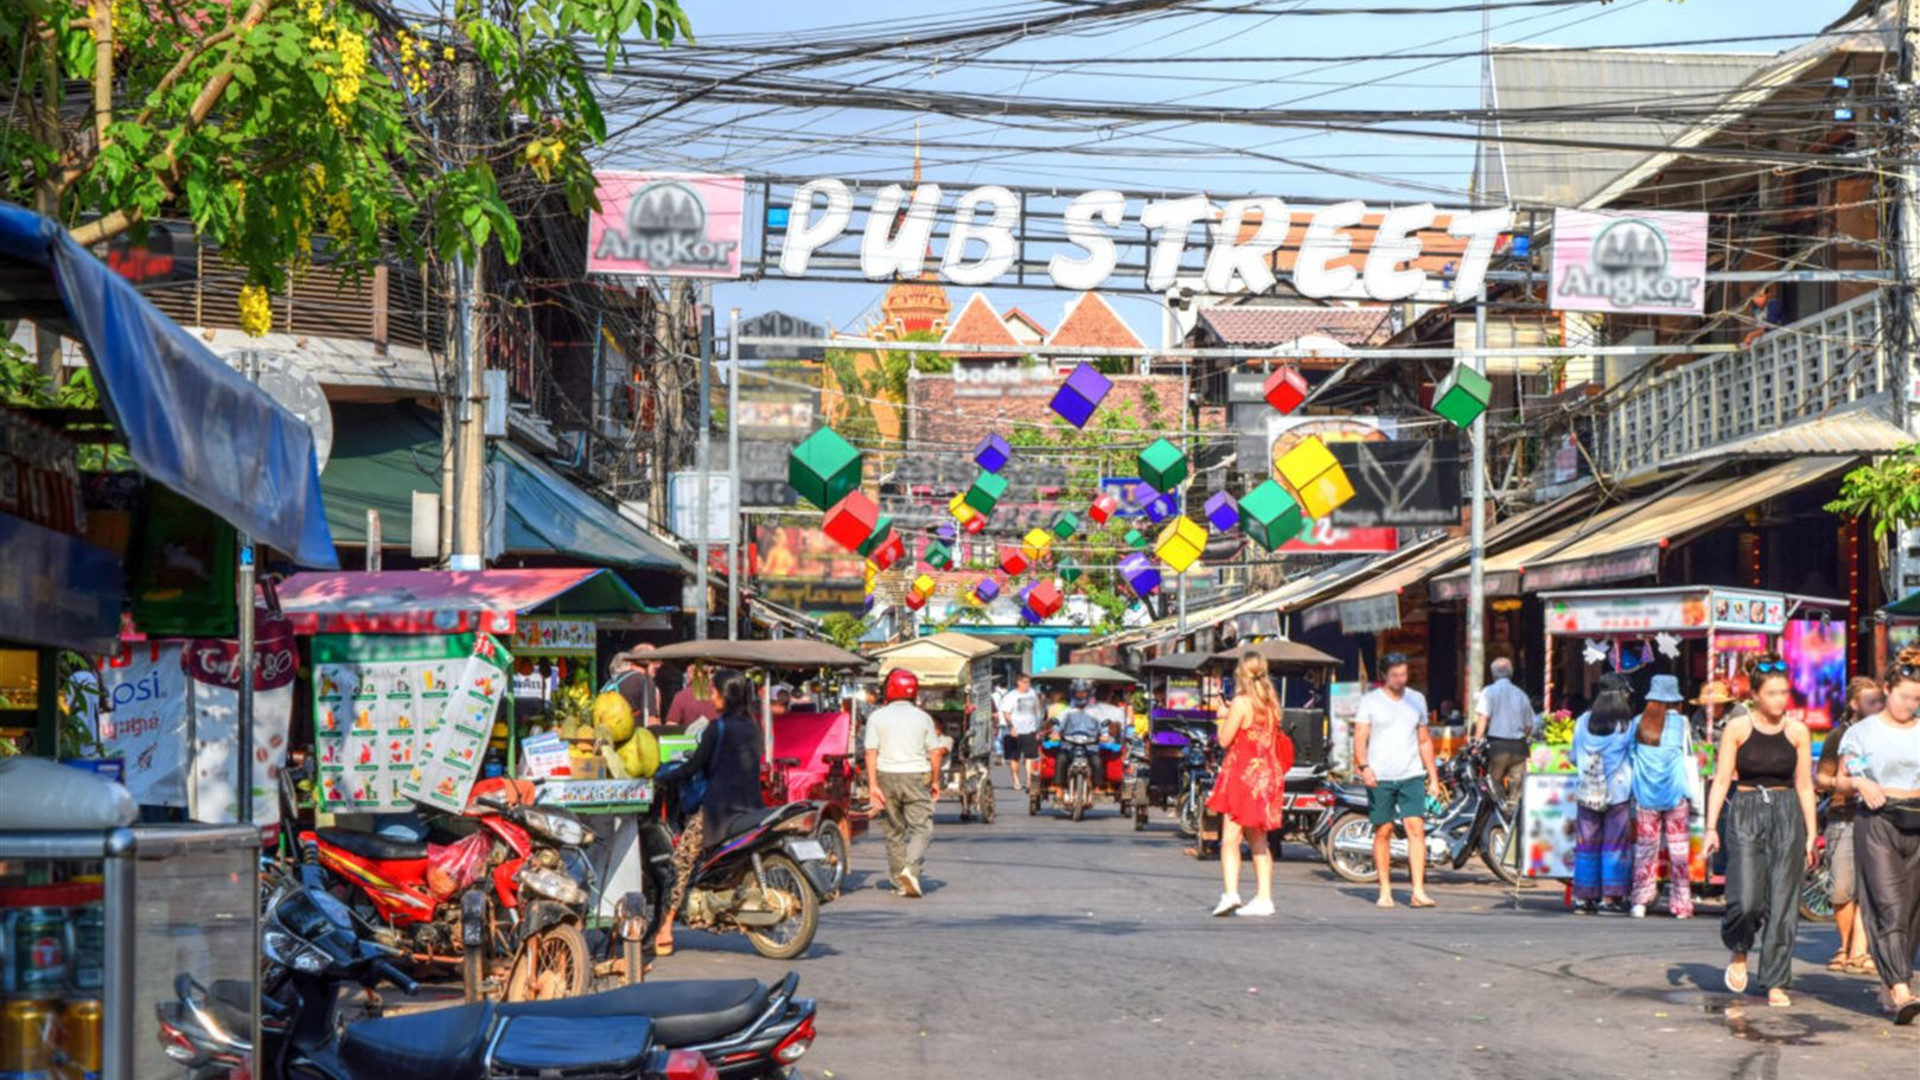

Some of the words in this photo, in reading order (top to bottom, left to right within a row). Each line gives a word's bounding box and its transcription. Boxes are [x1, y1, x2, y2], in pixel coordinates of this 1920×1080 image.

[596, 229, 737, 269] Angkor
[780, 178, 1020, 285] PUB
[1048, 190, 1515, 302] STREET
[1559, 264, 1700, 308] Angkor
[106, 672, 161, 711] psi
